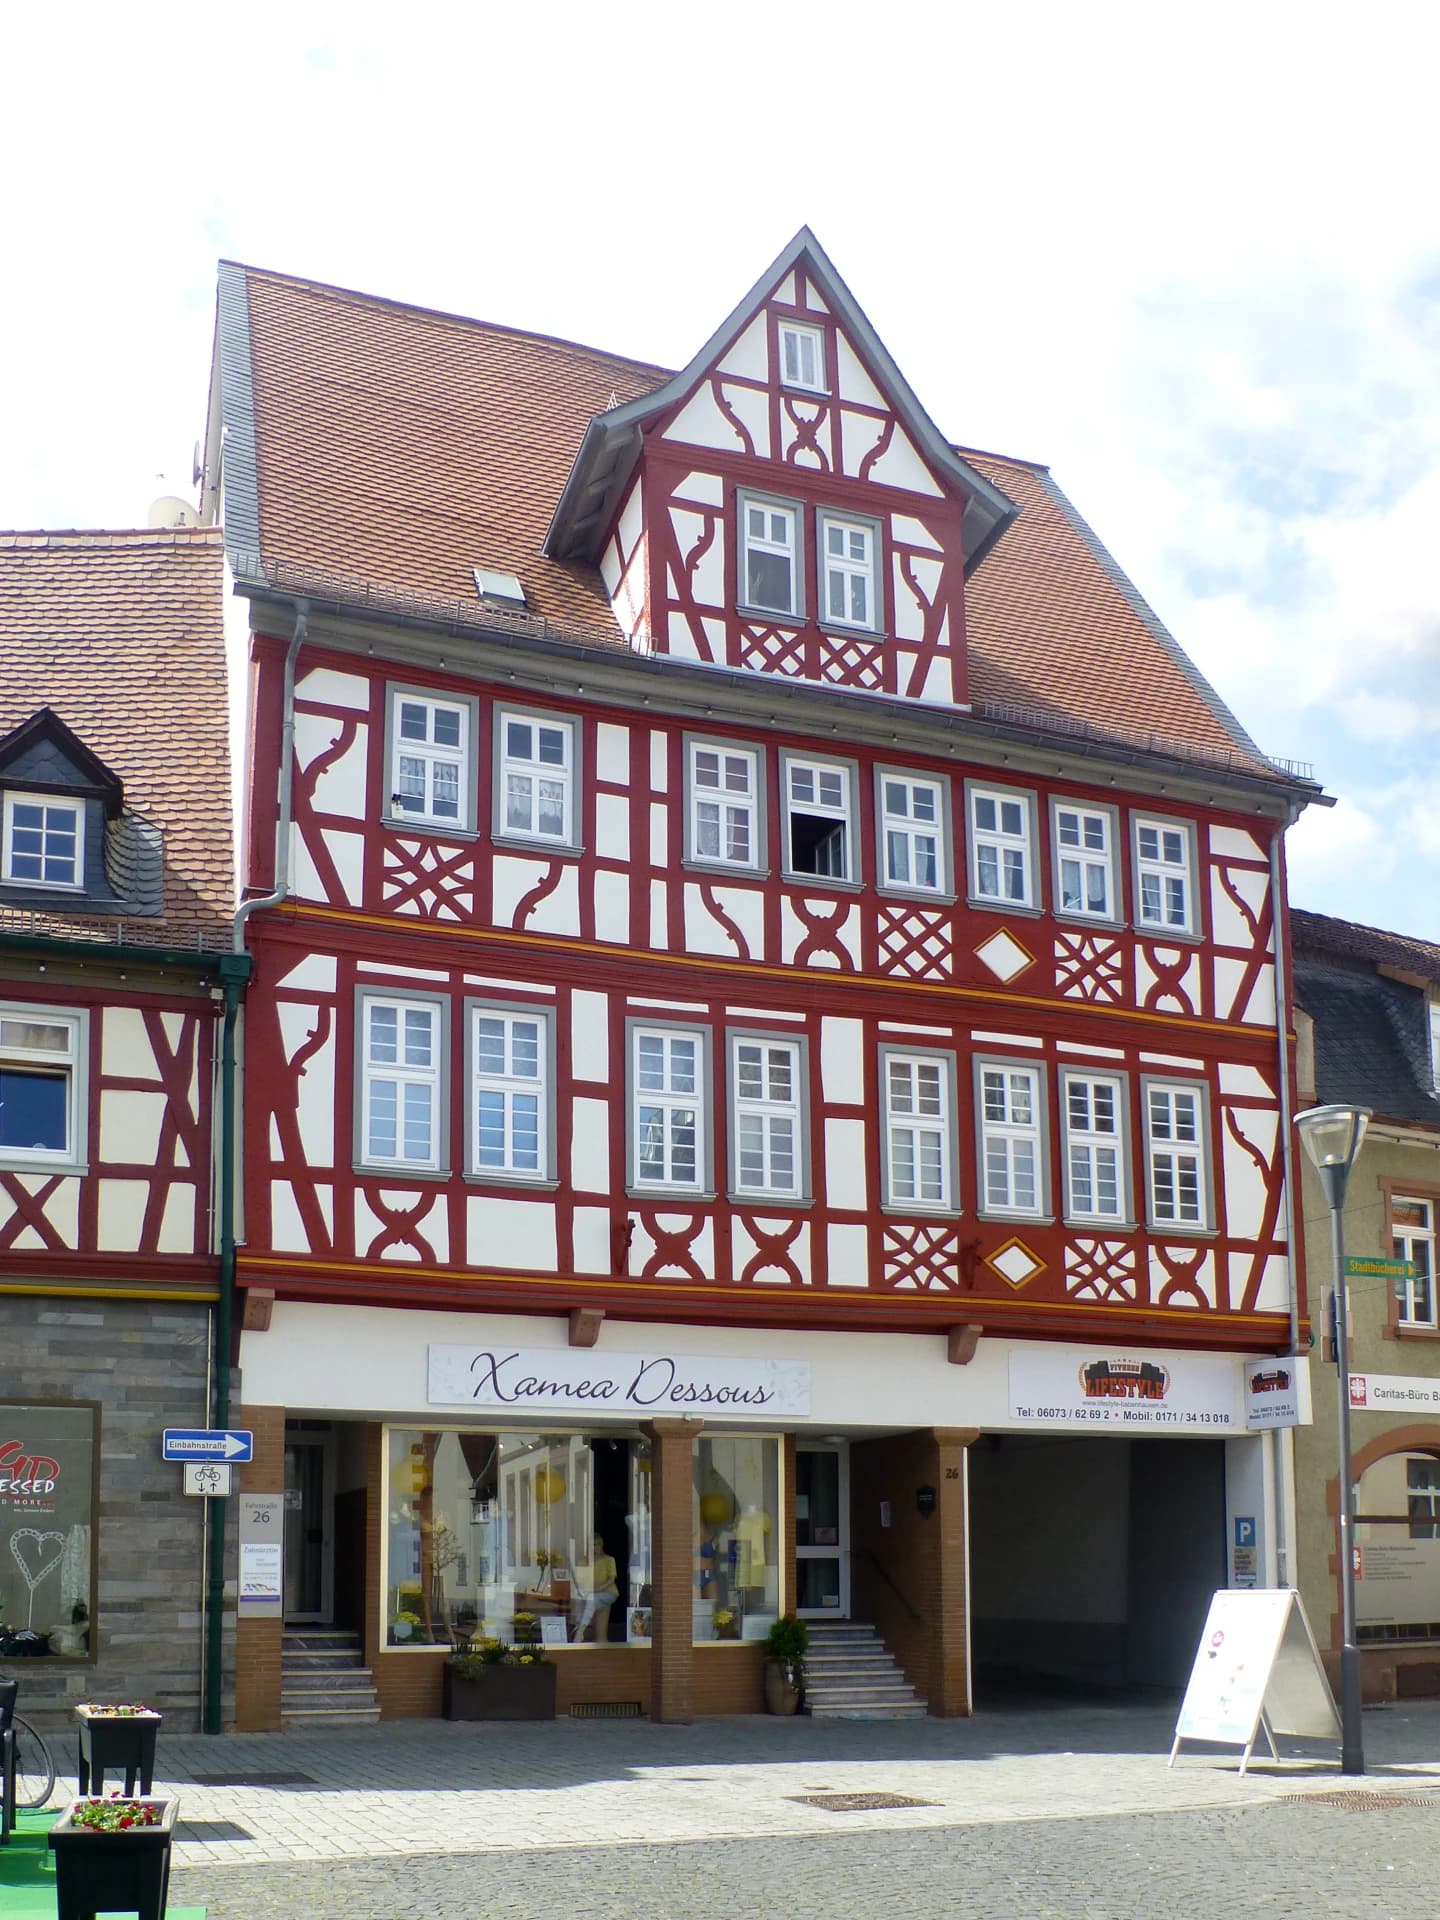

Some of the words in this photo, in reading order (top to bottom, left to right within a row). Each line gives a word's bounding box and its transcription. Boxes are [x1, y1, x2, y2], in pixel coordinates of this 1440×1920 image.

[470, 1352, 619, 1402] Xamea
[626, 1358, 774, 1405] Dessous
[1086, 1377, 1164, 1399] LIFESTYLE
[1374, 1387, 1430, 1401] Caritas-Büro
[1016, 1407, 1034, 1417] Tel:
[1037, 1408, 1067, 1418] 06073
[1075, 1409, 1087, 1419] 62
[1089, 1409, 1101, 1420] 69
[1103, 1410, 1110, 1420] 2
[1123, 1411, 1153, 1421] Mobil:
[1155, 1412, 1178, 1421] 0171
[1186, 1412, 1197, 1422] 34
[1200, 1413, 1211, 1423] 13
[1213, 1414, 1230, 1423] 018
[169, 1441, 227, 1450] Einbahnstraße
[945, 1467, 959, 1480] 26
[252, 1510, 270, 1523] 26
